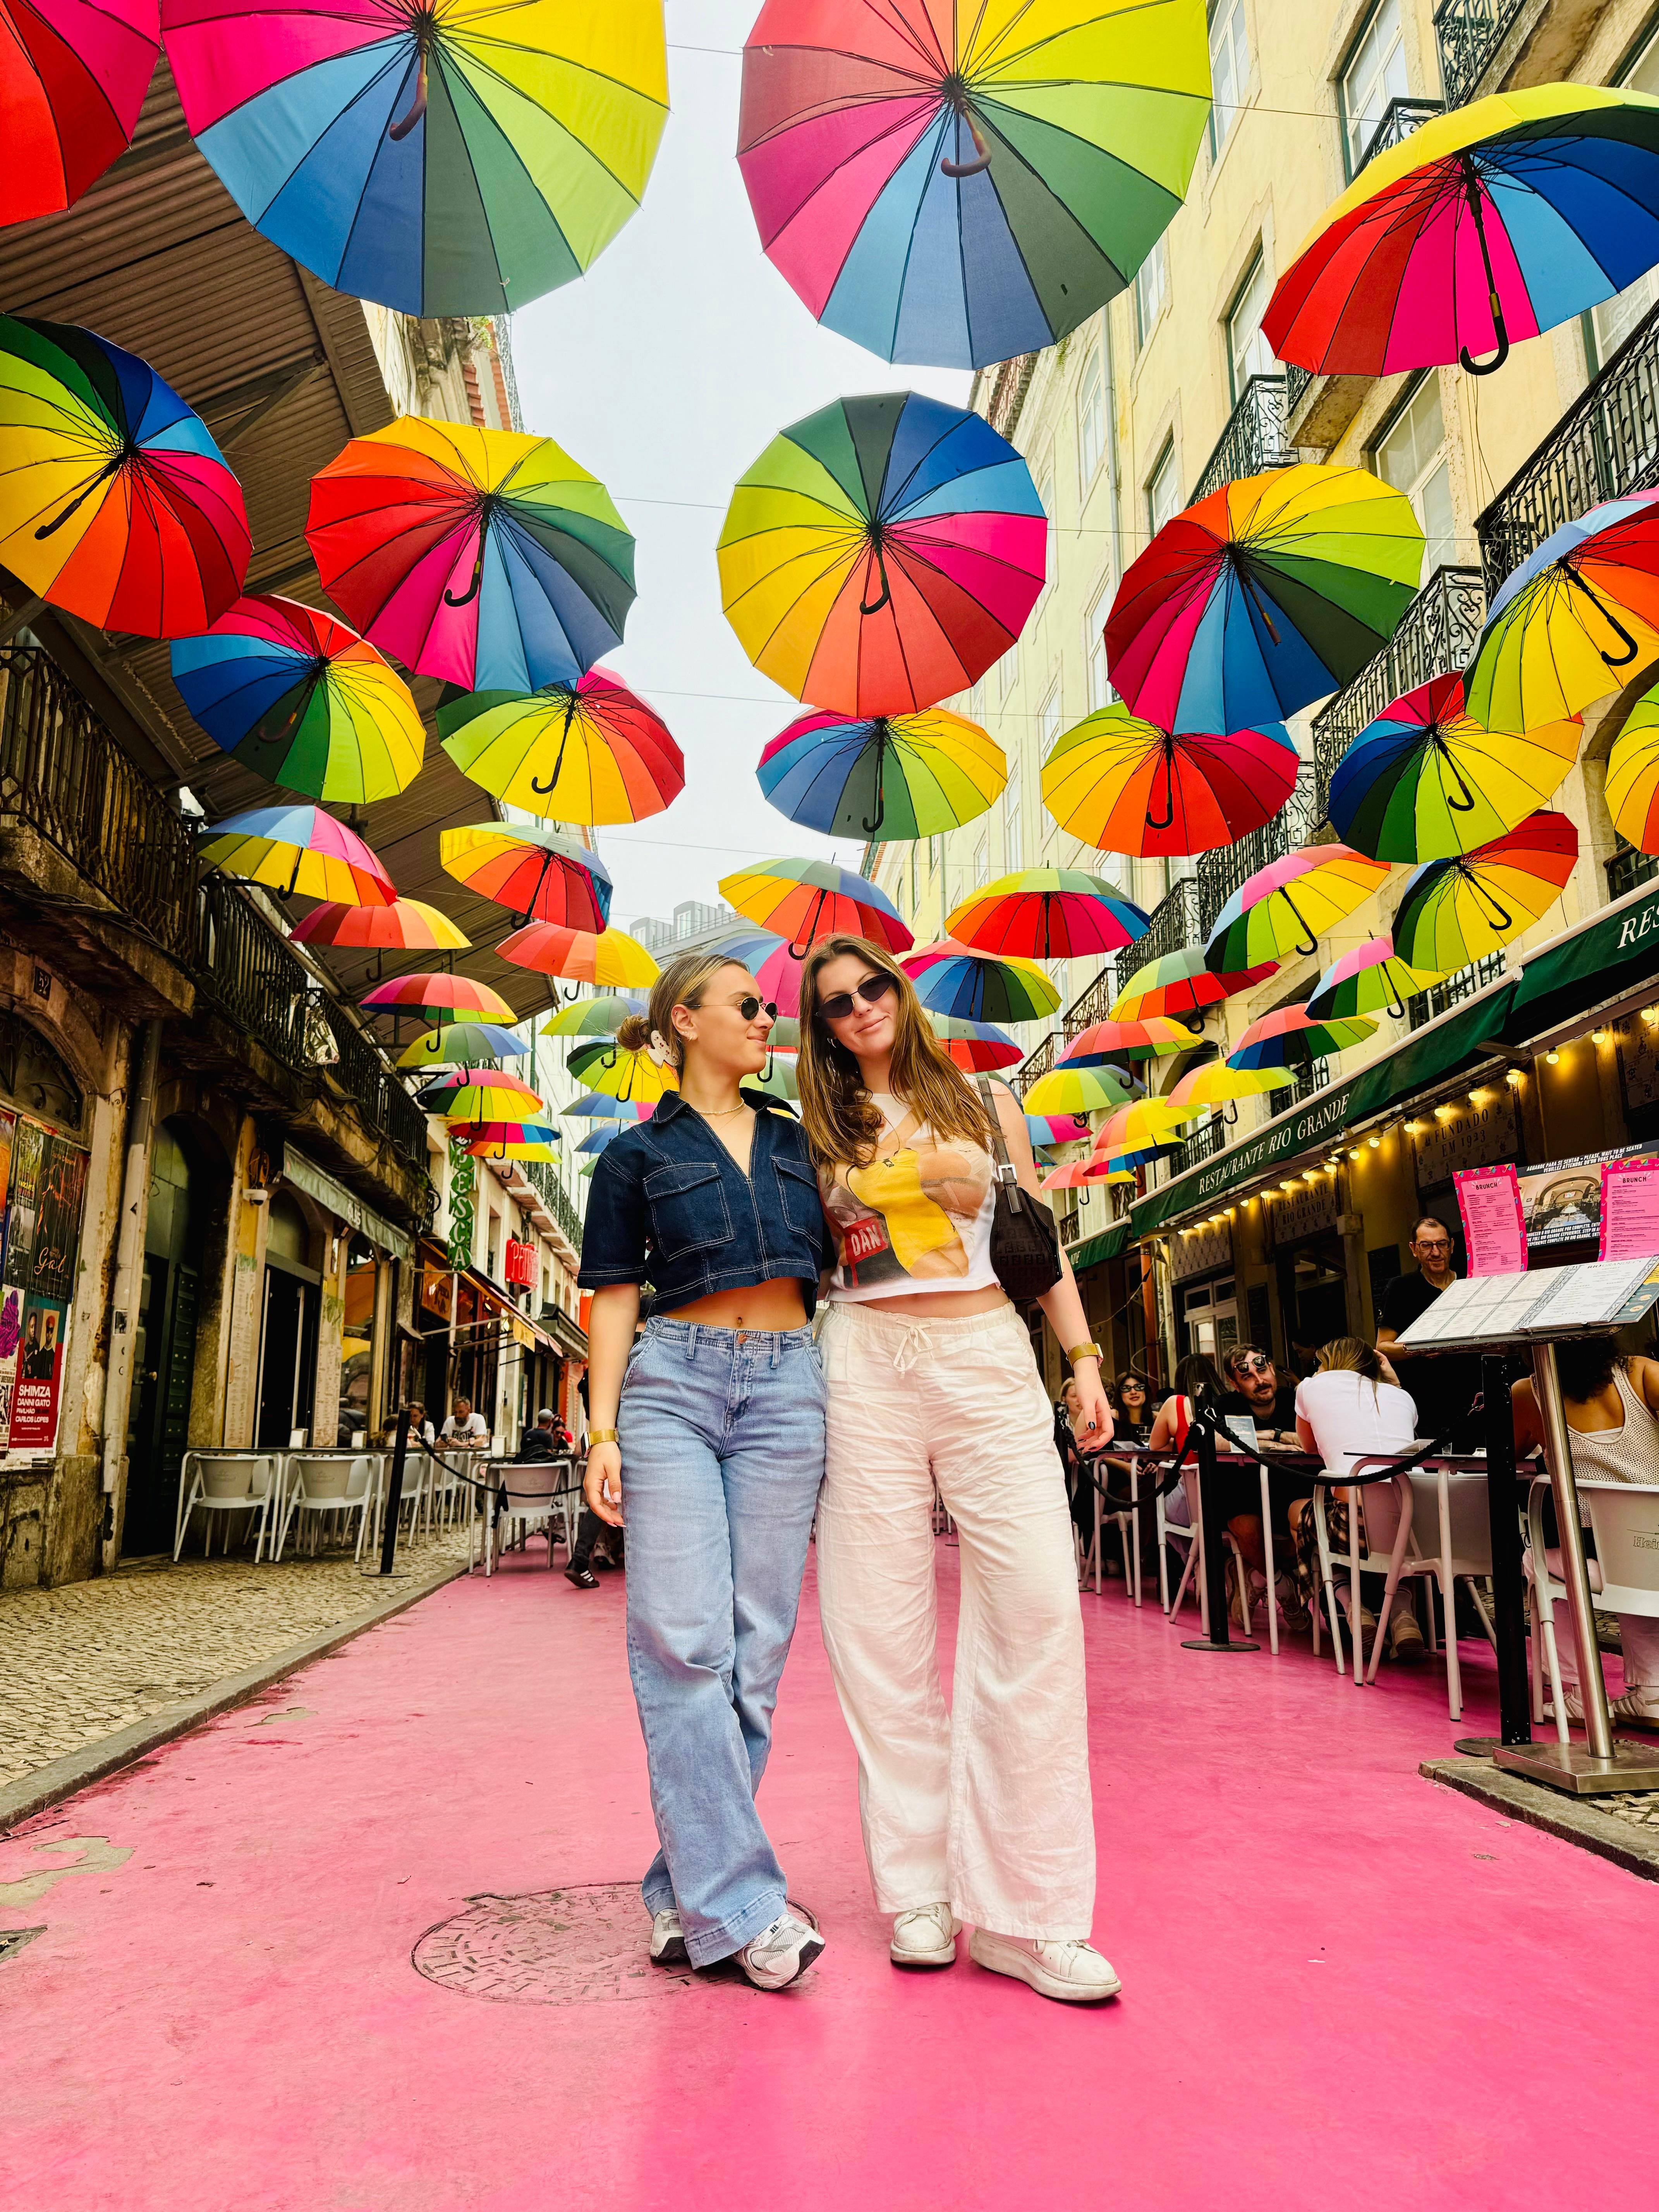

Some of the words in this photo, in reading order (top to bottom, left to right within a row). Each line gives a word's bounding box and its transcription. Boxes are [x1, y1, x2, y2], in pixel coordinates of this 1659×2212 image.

[1435, 1109, 1488, 1143] FUNDADO
[1199, 1142, 1265, 1195] RESTAURANTE
[1267, 1127, 1291, 1154] RIO
[1297, 1093, 1350, 1140] GRANDE
[1442, 1139, 1455, 1158] EM
[1462, 1130, 1486, 1148] 1923
[1626, 1144, 1642, 1152] SEATED
[1562, 1161, 1583, 1170] ATTENDRE
[1279, 1183, 1327, 1212] RESTAURANTE
[1283, 1212, 1294, 1225] RIO
[1297, 1198, 1326, 1219] GRANDE
[851, 1224, 881, 1256] DAN
[34, 1247, 67, 1275] Gal
[17, 1398, 34, 1407] DANNI
[35, 1399, 50, 1407] GATO
[19, 1384, 51, 1398] SHIMZA
